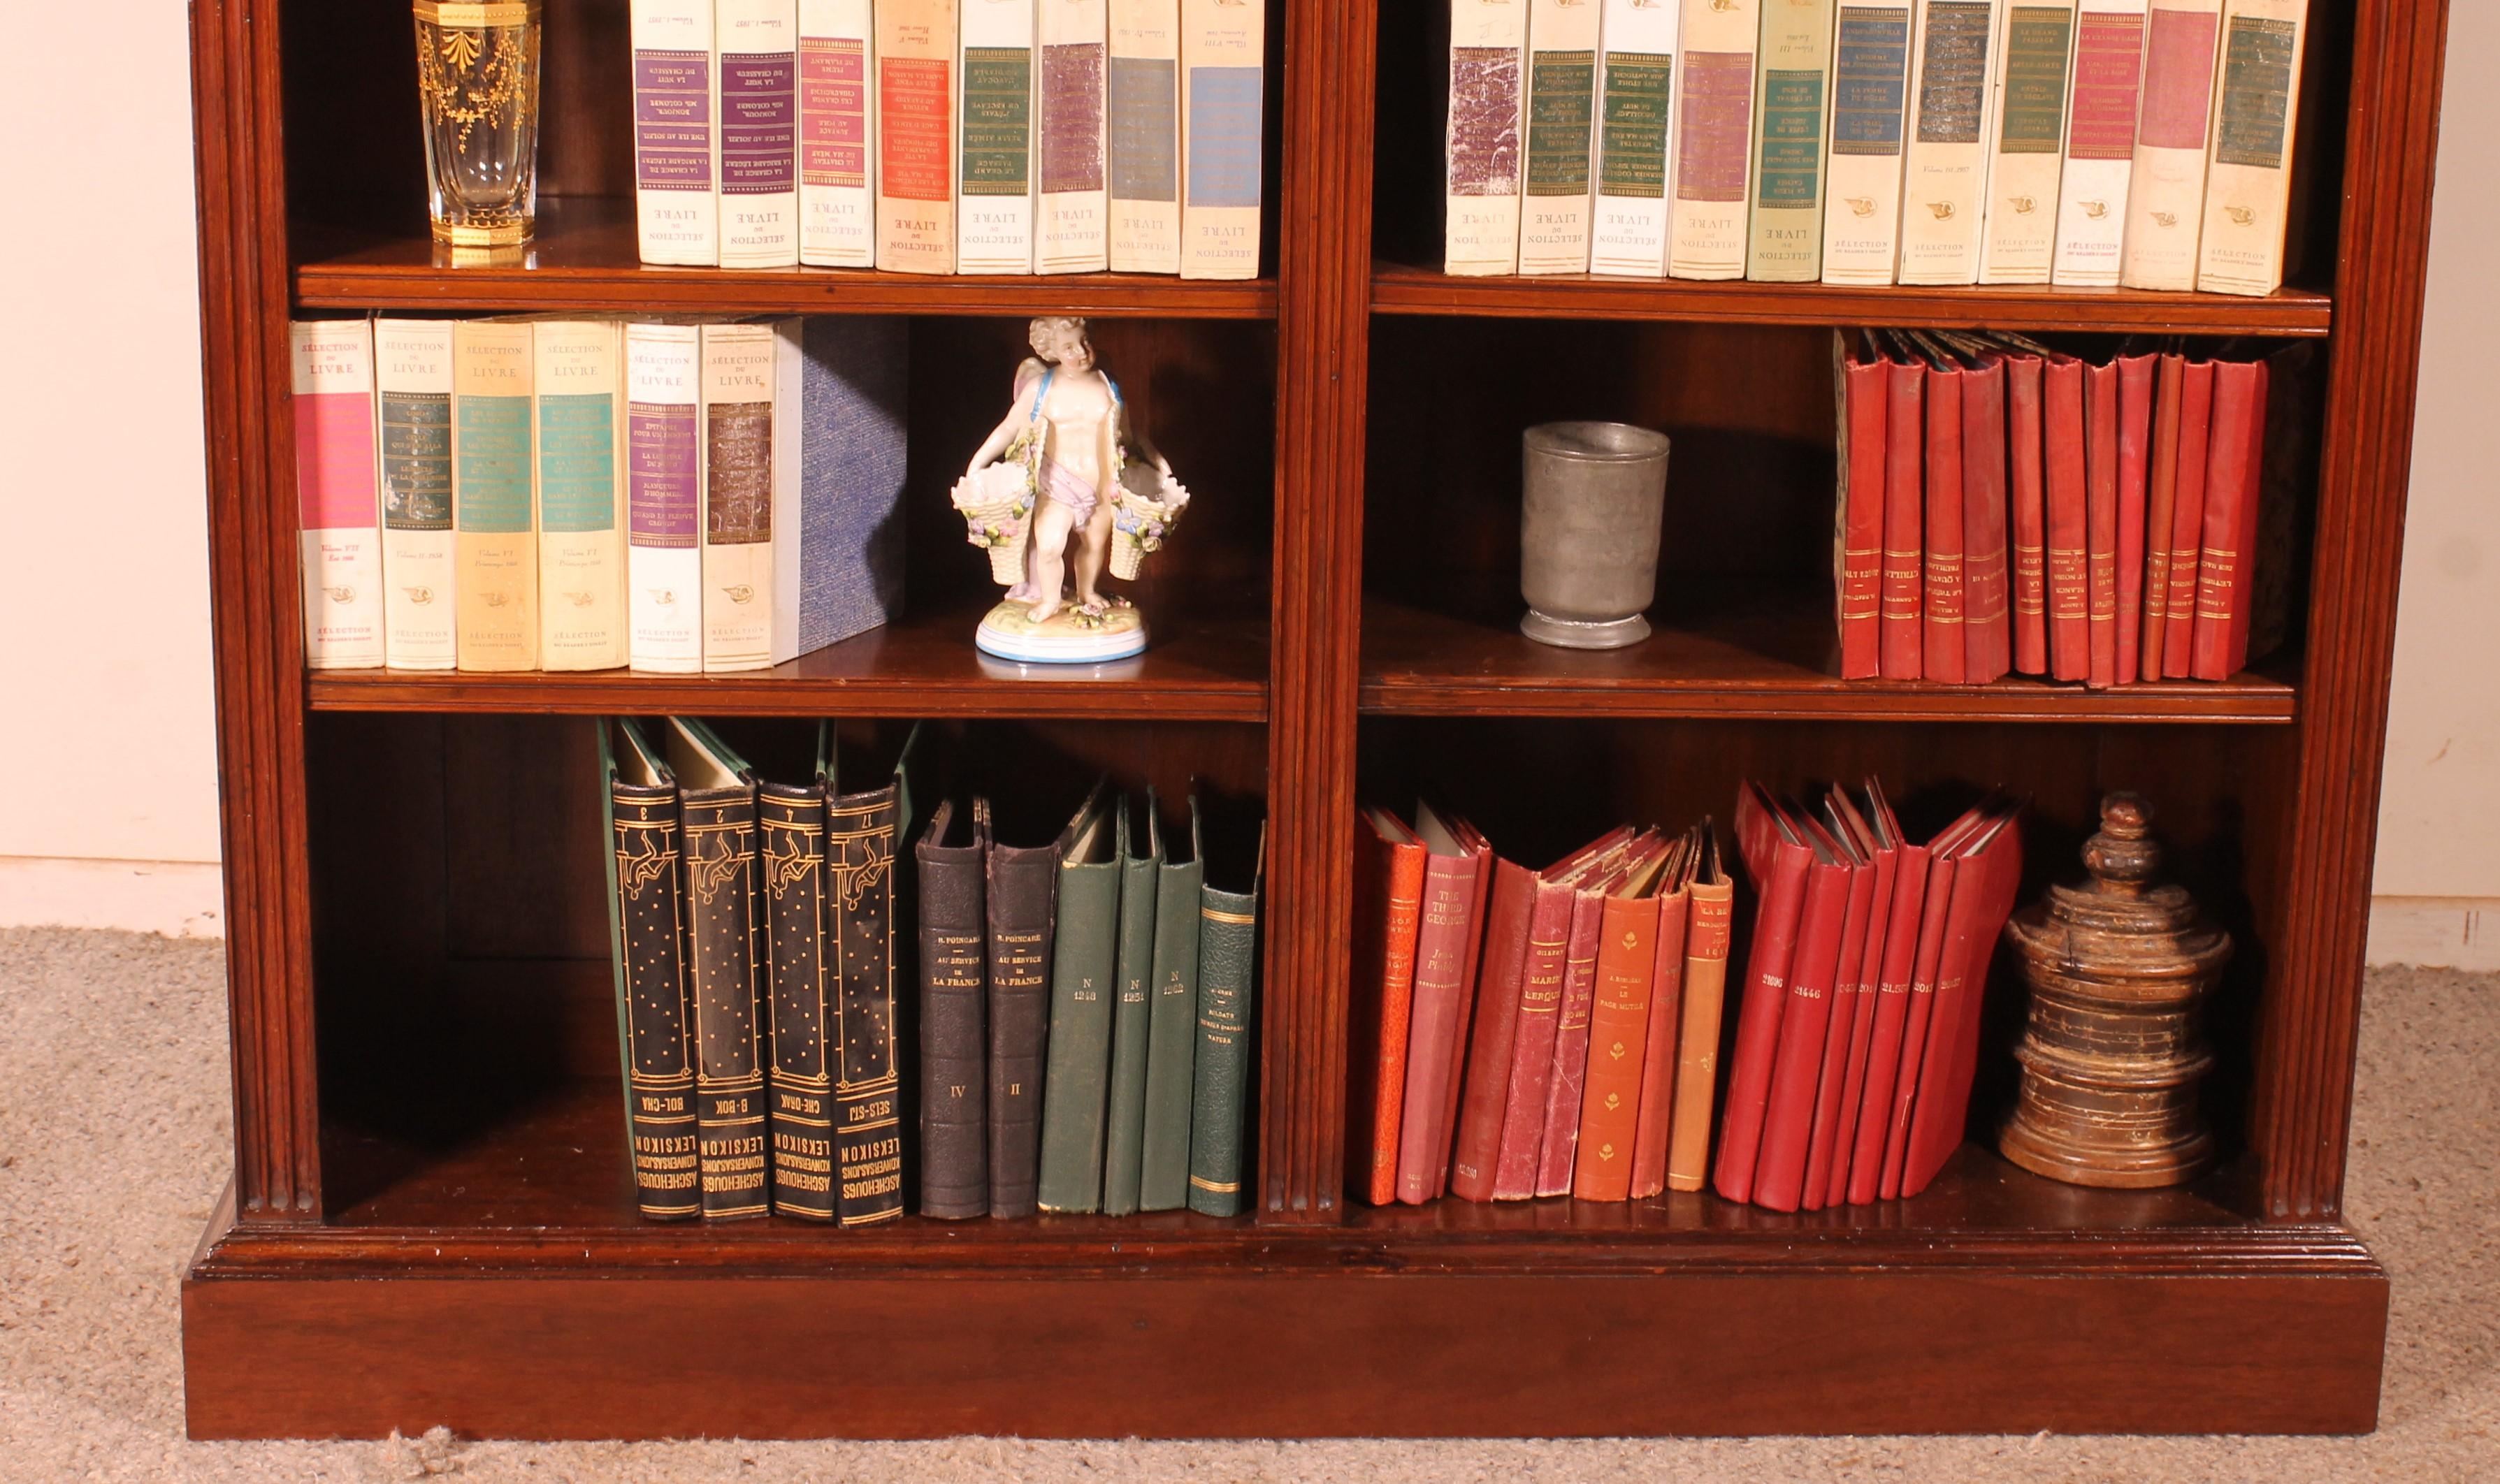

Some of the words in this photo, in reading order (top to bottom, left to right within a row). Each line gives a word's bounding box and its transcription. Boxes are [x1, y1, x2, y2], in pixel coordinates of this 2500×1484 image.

[811, 203, 854, 214] LIVRE
[654, 210, 696, 219] LIVRE
[737, 212, 779, 223] LIVRE
[973, 214, 1016, 223] LIVRE
[1052, 209, 1092, 220] LIVRE
[1536, 214, 1576, 224] LIVRE
[1607, 214, 1650, 224] LIVRE
[895, 219, 937, 231] LIVRE
[1124, 218, 1163, 229] LIVRE
[1689, 218, 1731, 228] LIVRE
[805, 226, 862, 235] SÉLECTION
[1046, 231, 1100, 241] SÉLECTION
[1202, 226, 1245, 236] LIVRE
[1765, 229, 1807, 238] LIVRE
[649, 232, 703, 241] SÉLECTION
[730, 235, 784, 244] SÉLECTION
[964, 235, 1023, 244] SÉLECTION
[1528, 235, 1582, 244] SÉLECTION
[1598, 235, 1657, 245] SÉLECTION
[890, 241, 944, 252] SÉLECTION
[1115, 241, 1171, 251] SÉLECTION
[1197, 249, 1252, 258] SÉLECTION
[302, 343, 358, 353] SÉLECTION
[384, 342, 444, 351] SÉLECTION
[465, 347, 522, 356] SÉLECTION
[547, 345, 602, 354] SÉLECTION
[633, 356, 690, 365] SÉLECTION
[712, 356, 769, 365] SÉLECTION
[310, 363, 354, 375] LIVRE
[393, 363, 436, 374] LIVRE
[473, 367, 516, 378] LIVRE
[554, 366, 598, 376] LIVRE
[641, 376, 682, 387] LIVRE
[719, 375, 761, 386] LIVRE
[633, 512, 653, 521] QUAND
[670, 512, 693, 521] FLEUVE
[640, 807, 646, 820] 3
[716, 809, 723, 823] 2
[786, 808, 794, 822] 4
[862, 814, 872, 828] 17
[1439, 890, 1459, 901] THE
[1433, 901, 1462, 912] THIRD
[1426, 913, 1465, 926] GEORGE
[932, 977, 944, 986] LA
[1009, 976, 1043, 985] FRANCE
[1171, 971, 1179, 982] N
[1531, 976, 1560, 984] MARIE
[1083, 979, 1092, 989] N
[1130, 980, 1139, 990] N
[951, 1085, 965, 1098] IV
[1011, 1083, 1020, 1096] II
[642, 1096, 684, 1112] BOL-CHA
[781, 1094, 820, 1114] CHE-DRAK
[849, 1100, 890, 1120] SELS-STJ
[635, 1135, 696, 1151] LEKSIKON
[700, 1136, 763, 1156] LEKSIKON
[774, 1133, 830, 1156] LEKSIKON
[841, 1137, 899, 1163] LEKSIKON
[636, 1155, 697, 1170] KONVERSASJONS
[701, 1156, 764, 1172] KONVERSASJONS
[775, 1151, 830, 1172] KONVERSASJONS
[841, 1156, 900, 1179] KONVERSASJONS
[637, 1171, 697, 1188] ASCHEHOUGS
[702, 1172, 764, 1192] ASCHEHOUGS
[776, 1169, 830, 1191] ASCHEHOUGS
[843, 1174, 900, 1199] ASCHEHOUGS
